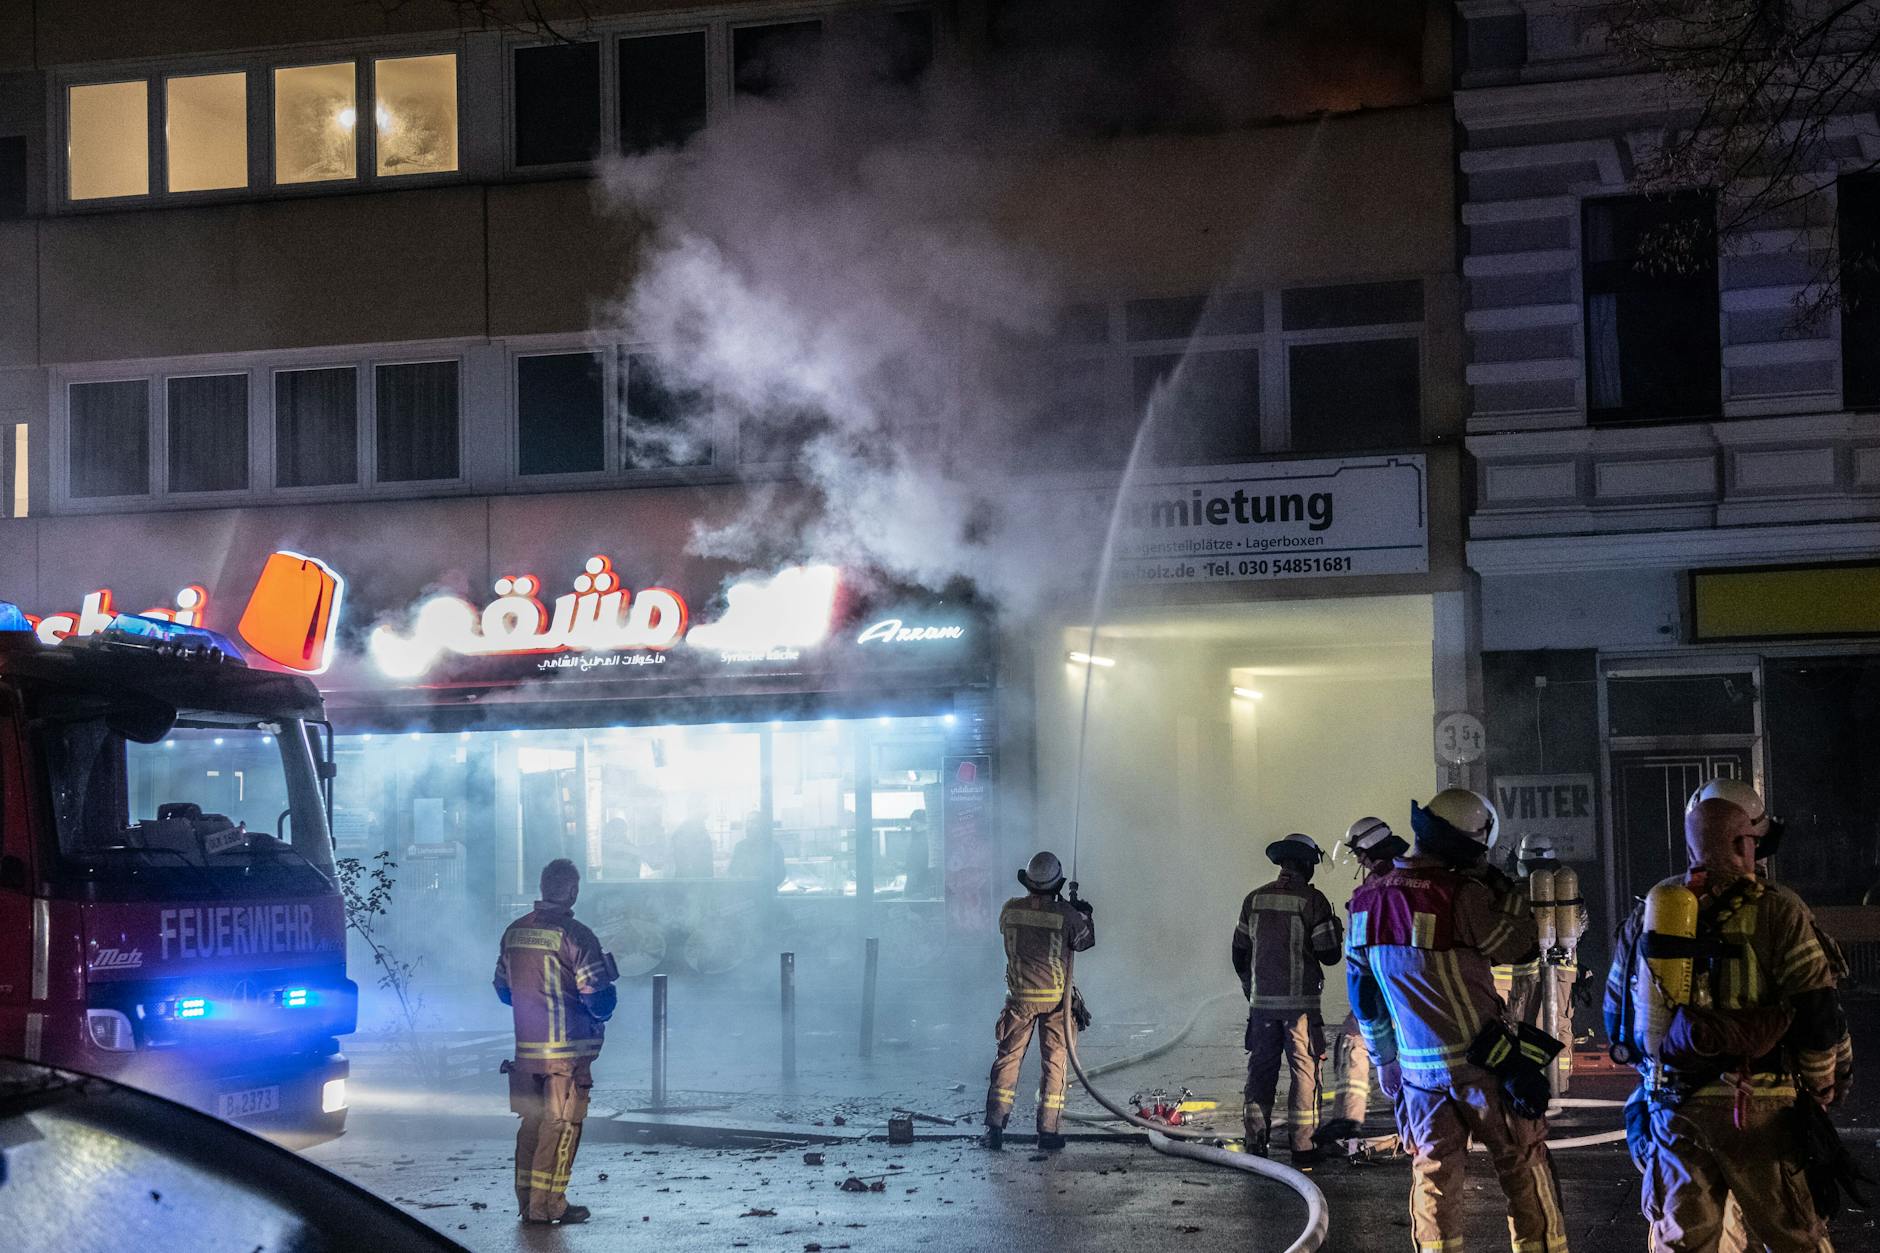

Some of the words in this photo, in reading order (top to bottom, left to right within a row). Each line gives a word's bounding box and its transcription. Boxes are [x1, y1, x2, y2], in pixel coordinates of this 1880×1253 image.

[1246, 534, 1324, 555] Lagerboxen
[1207, 560, 1234, 577] Tel.
[1238, 558, 1268, 576] 030
[1273, 556, 1353, 574] 54851681
[160, 904, 314, 960] FEUERWEHR
[91, 946, 143, 969] Metz
